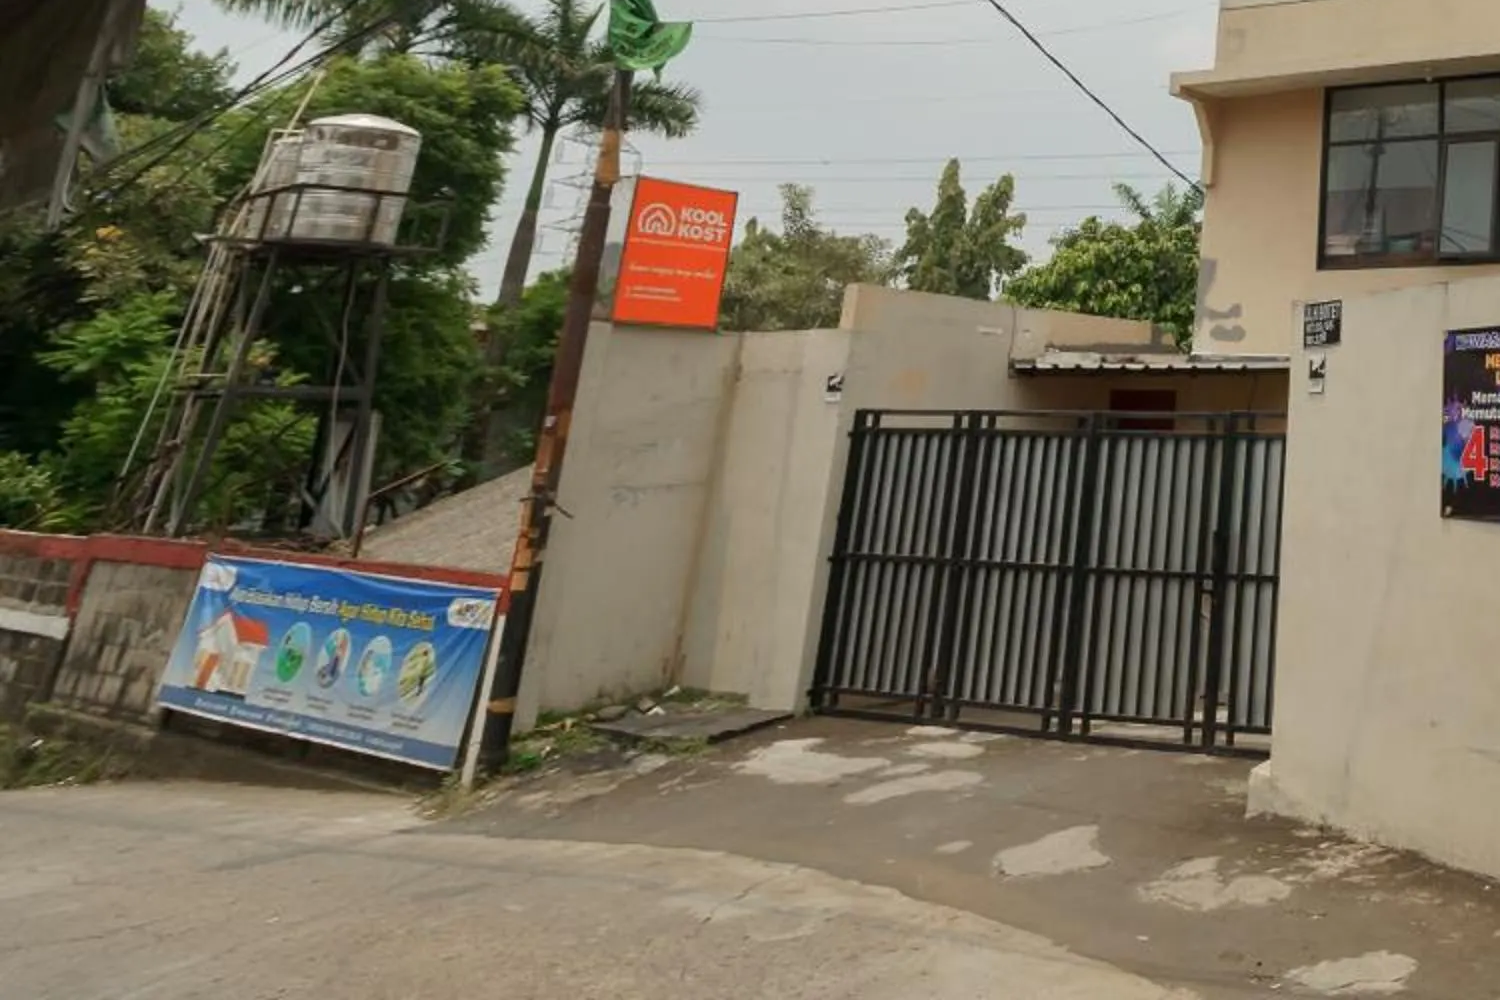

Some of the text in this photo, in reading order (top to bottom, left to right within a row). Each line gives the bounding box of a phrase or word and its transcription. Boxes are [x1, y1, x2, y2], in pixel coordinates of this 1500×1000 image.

[681, 206, 728, 227] KOOL
[679, 224, 727, 242] KOST
[1461, 425, 1489, 481] 4
